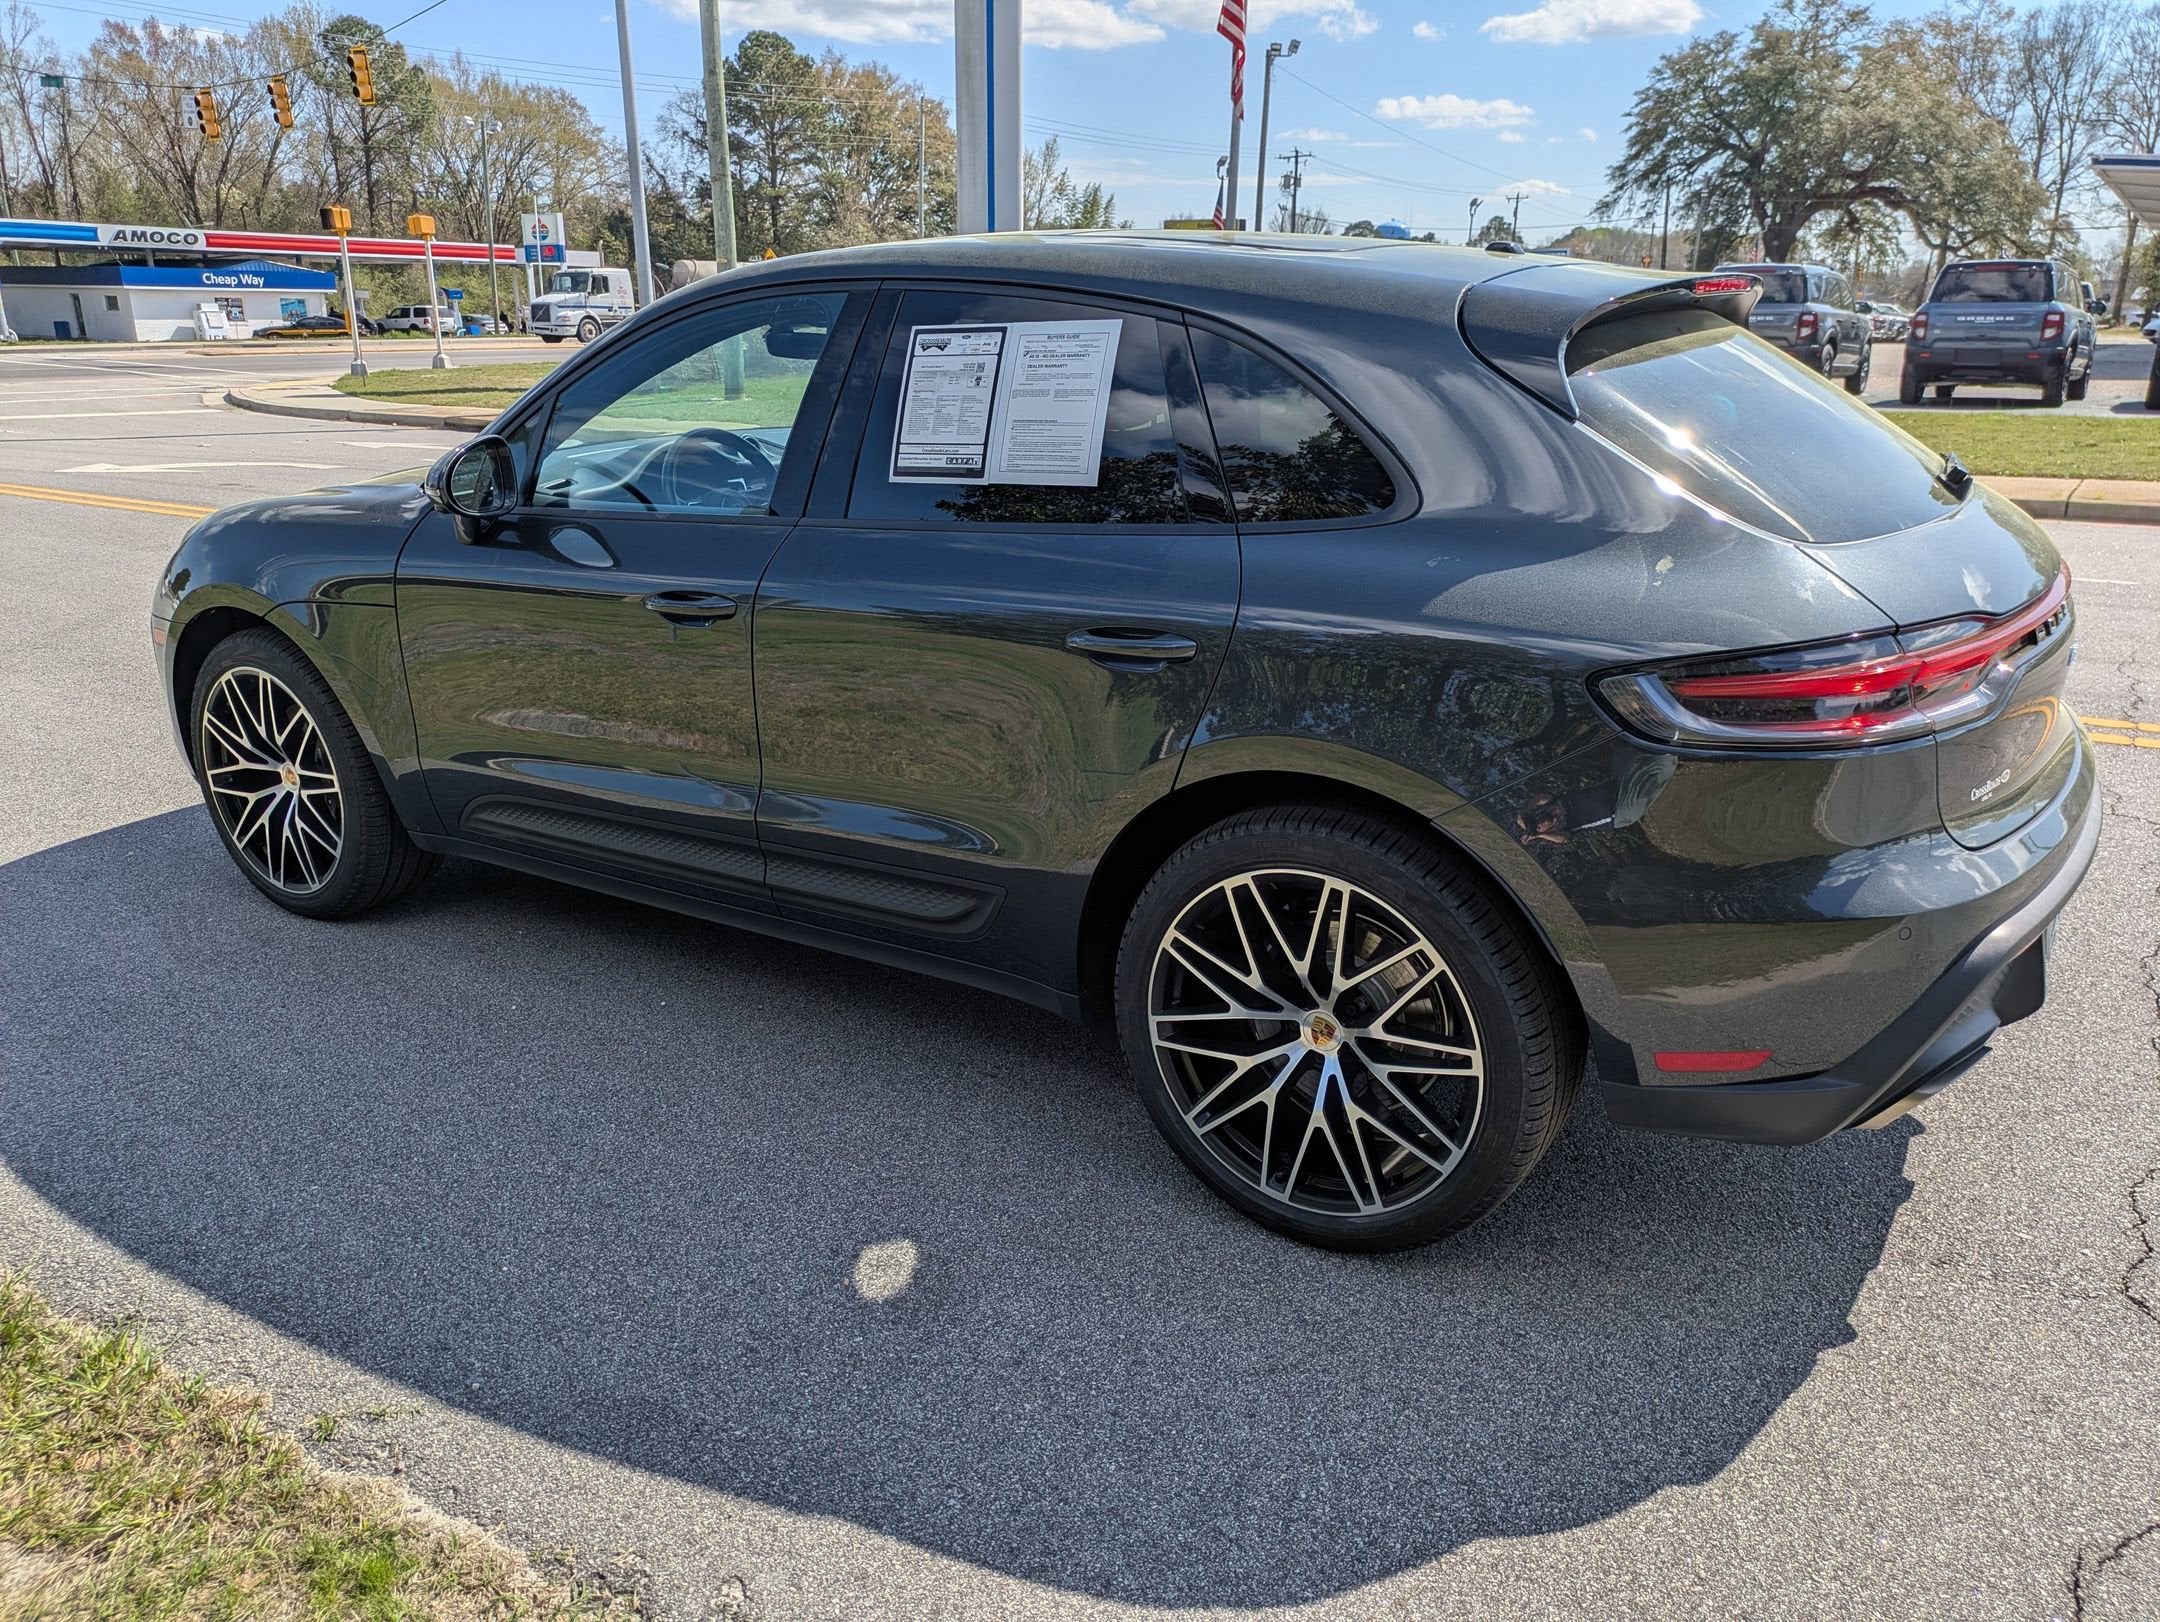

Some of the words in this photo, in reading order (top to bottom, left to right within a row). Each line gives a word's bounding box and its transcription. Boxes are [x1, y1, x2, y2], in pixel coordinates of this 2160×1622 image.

[112, 229, 199, 246] AMOCO
[202, 273, 238, 288] Cheap
[239, 273, 265, 288] Way
[946, 457, 980, 465] CARFAX
